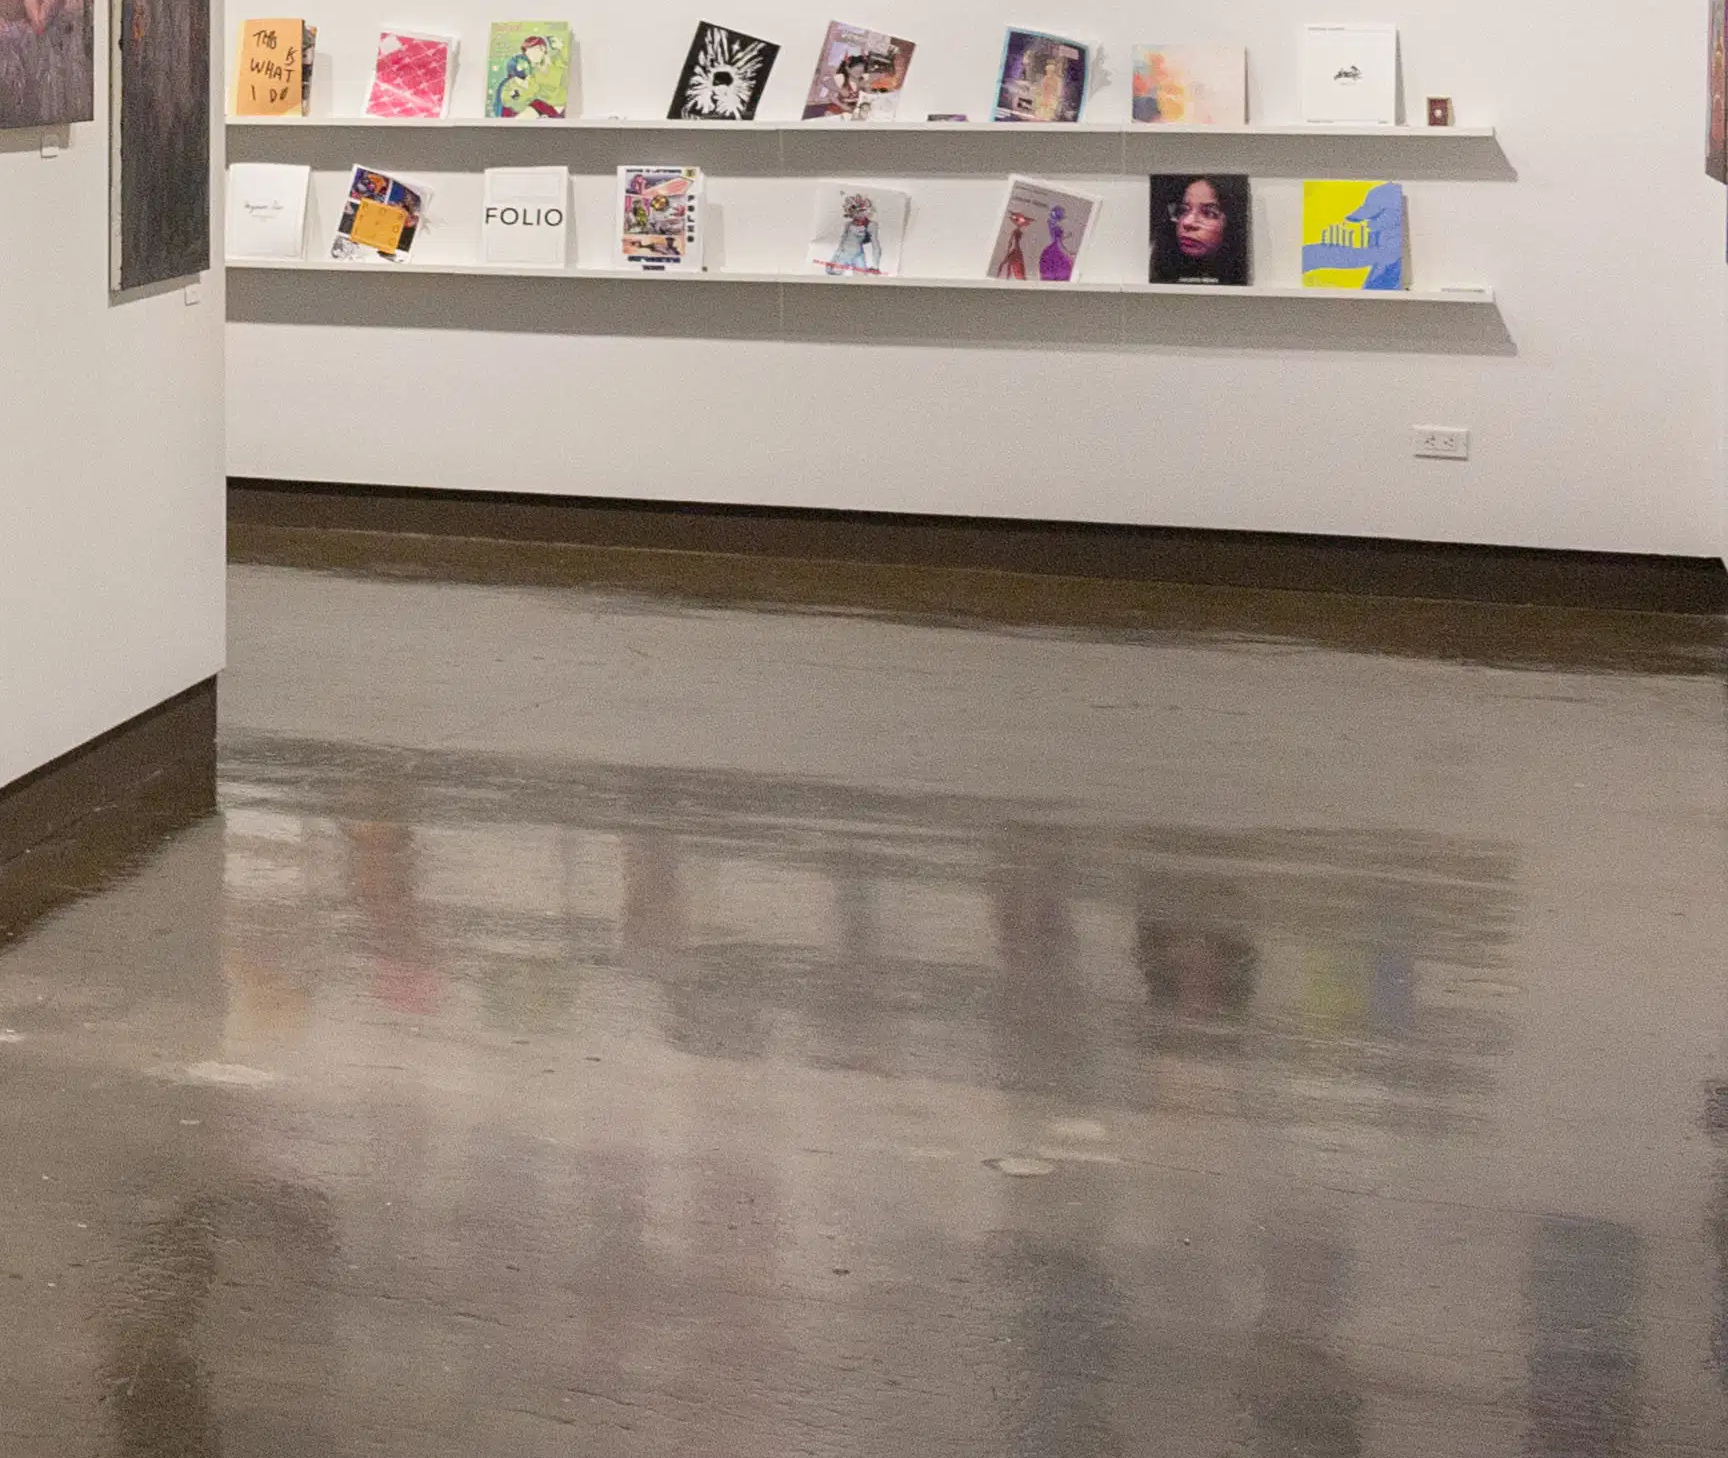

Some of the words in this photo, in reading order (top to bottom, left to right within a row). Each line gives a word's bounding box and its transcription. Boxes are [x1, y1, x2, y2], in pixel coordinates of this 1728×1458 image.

[250, 57, 296, 84] WHAT
[250, 84, 257, 101] I
[485, 207, 563, 227] FOLIO
